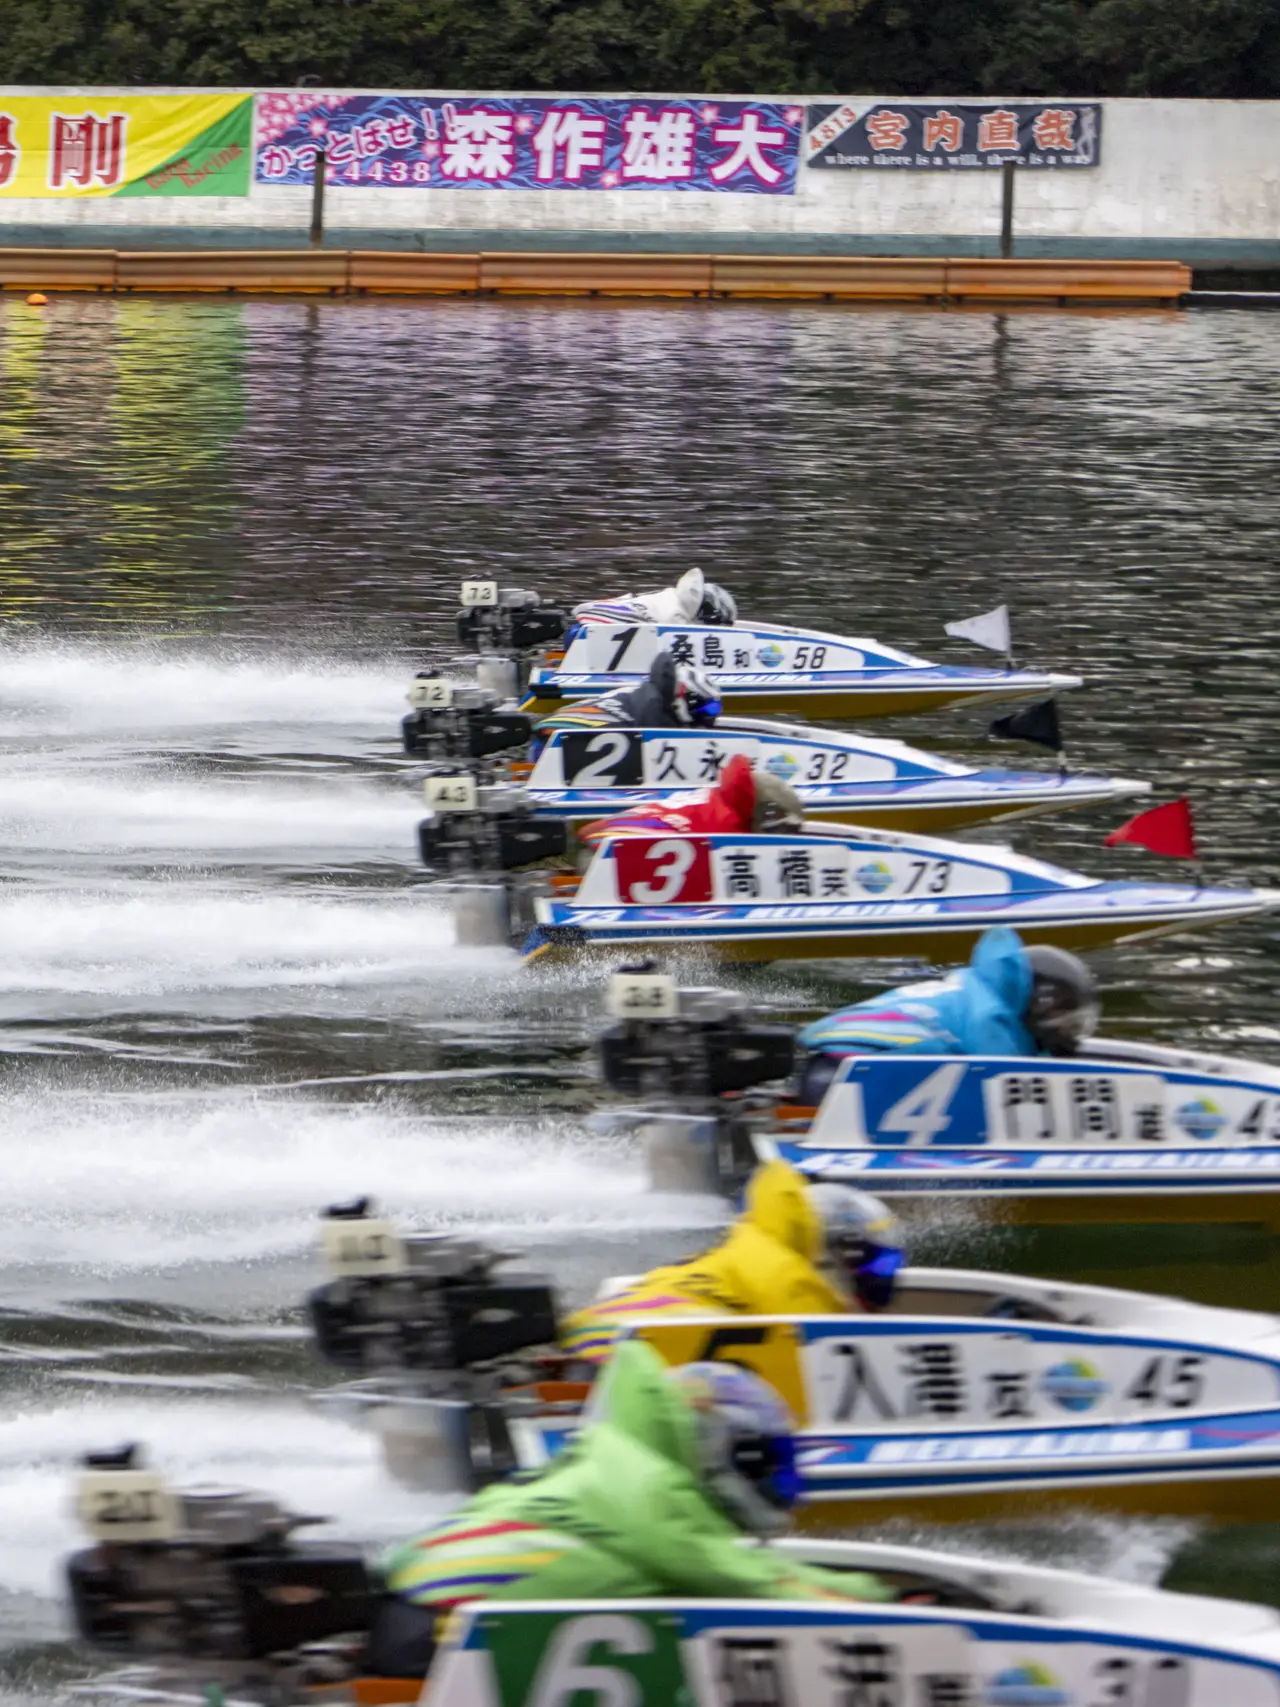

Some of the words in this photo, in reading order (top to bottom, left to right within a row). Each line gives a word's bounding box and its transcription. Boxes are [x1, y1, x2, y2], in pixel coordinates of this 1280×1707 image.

[866, 109, 1075, 150] 宮内直哉
[343, 160, 431, 182] 4438
[916, 154, 929, 165] is
[933, 156, 943, 165] a
[607, 627, 639, 671] 1
[793, 646, 827, 670] 58
[571, 733, 630, 785] 2
[807, 753, 848, 780] 32
[629, 839, 696, 904] 3
[903, 860, 952, 894] 73
[877, 1063, 967, 1145] 4
[1125, 1355, 1206, 1408] 45
[527, 1613, 658, 1707] 6
